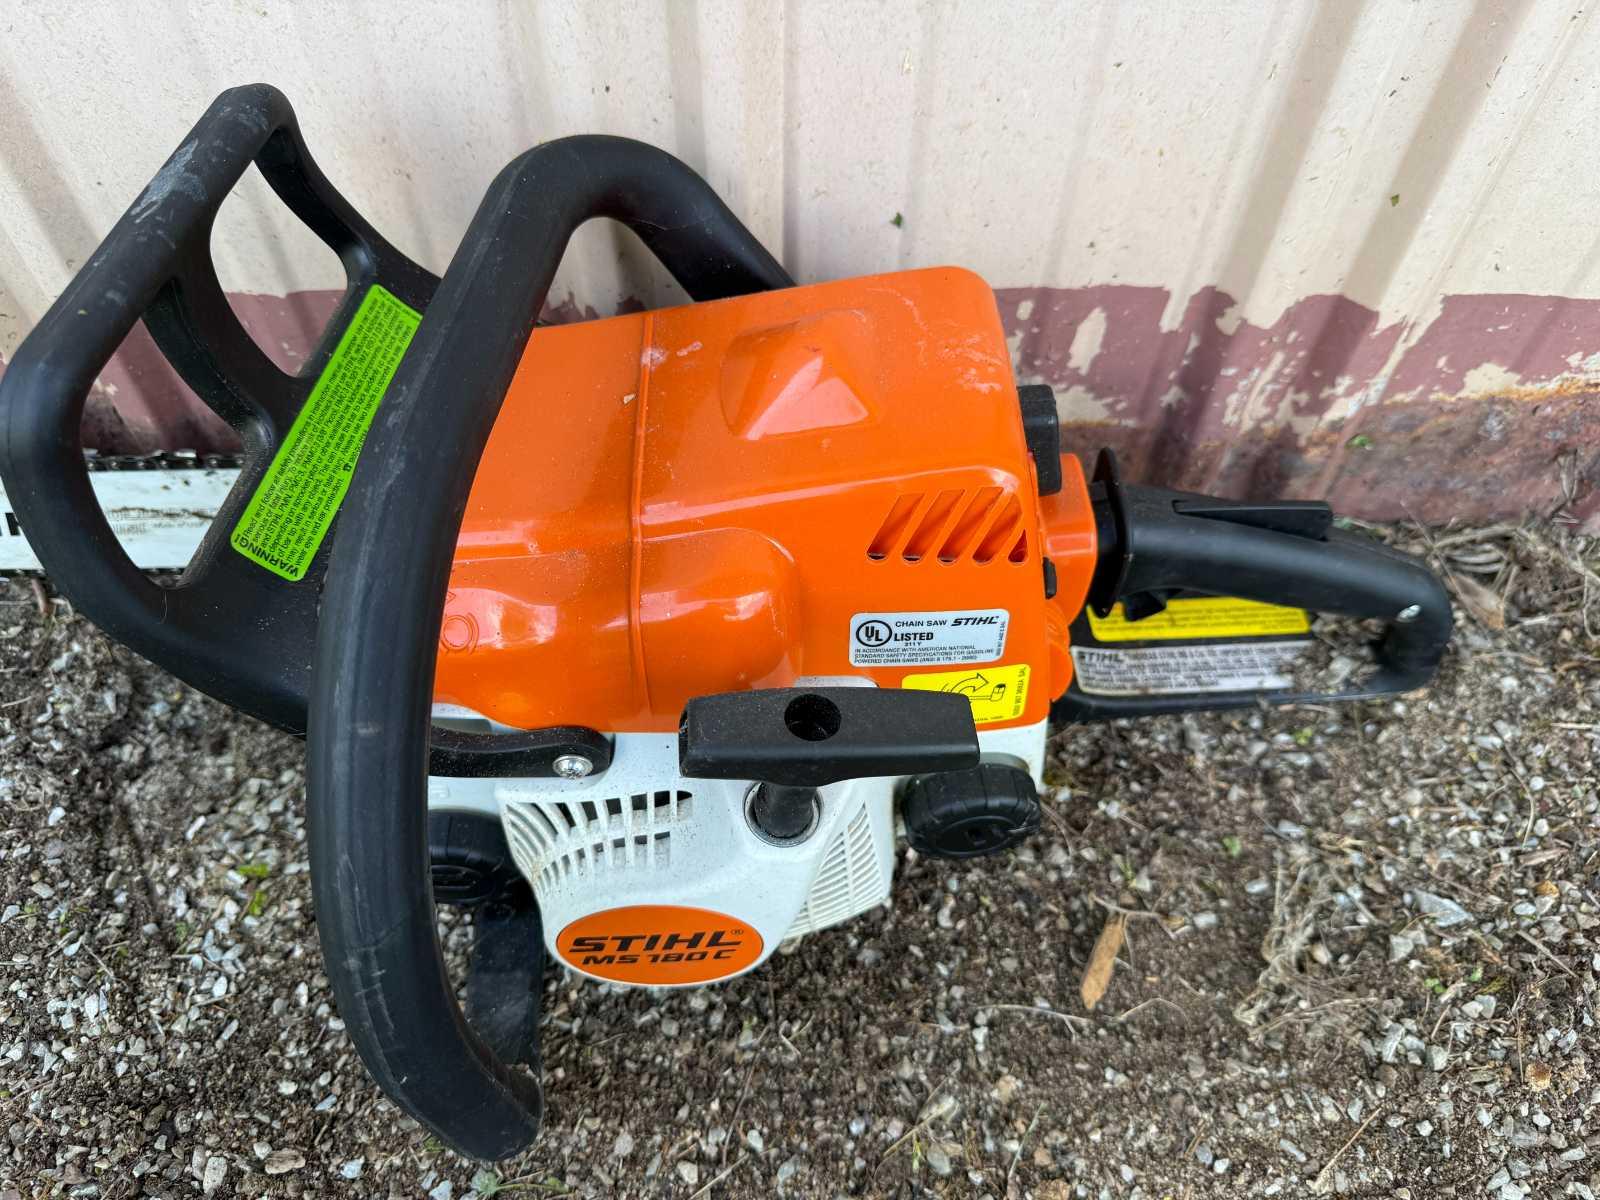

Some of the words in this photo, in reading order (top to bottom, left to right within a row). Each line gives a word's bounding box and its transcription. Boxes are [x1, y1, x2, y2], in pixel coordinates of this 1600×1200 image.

[265, 510, 283, 534] STIHL
[233, 533, 300, 577] WARNING!
[865, 626, 883, 641] UL
[894, 632, 933, 641] LISTED
[582, 955, 640, 965] MS
[646, 951, 708, 963] 180
[714, 950, 736, 959] C
